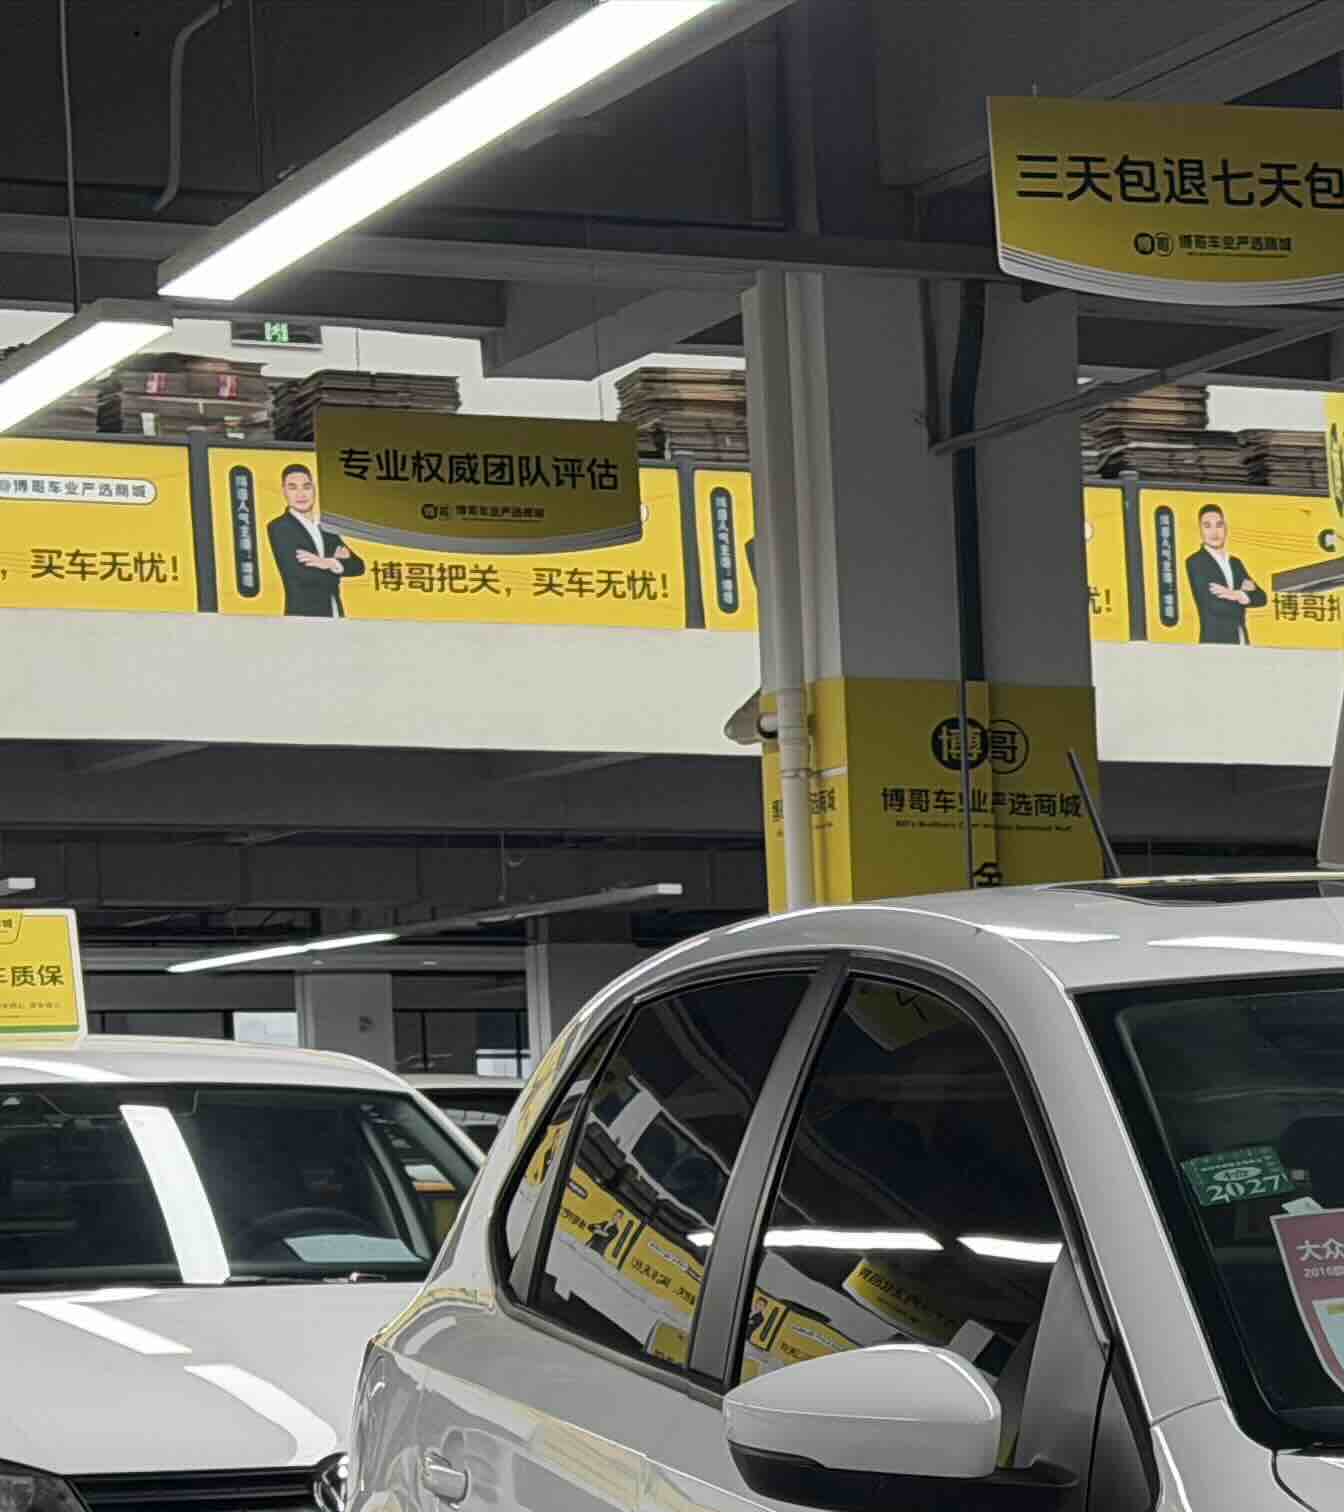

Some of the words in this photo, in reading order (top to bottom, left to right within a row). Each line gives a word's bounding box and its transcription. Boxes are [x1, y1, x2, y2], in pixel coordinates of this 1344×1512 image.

[340, 448, 619, 490] 专业权威团队评估
[1205, 1175, 1281, 1203] 2027
